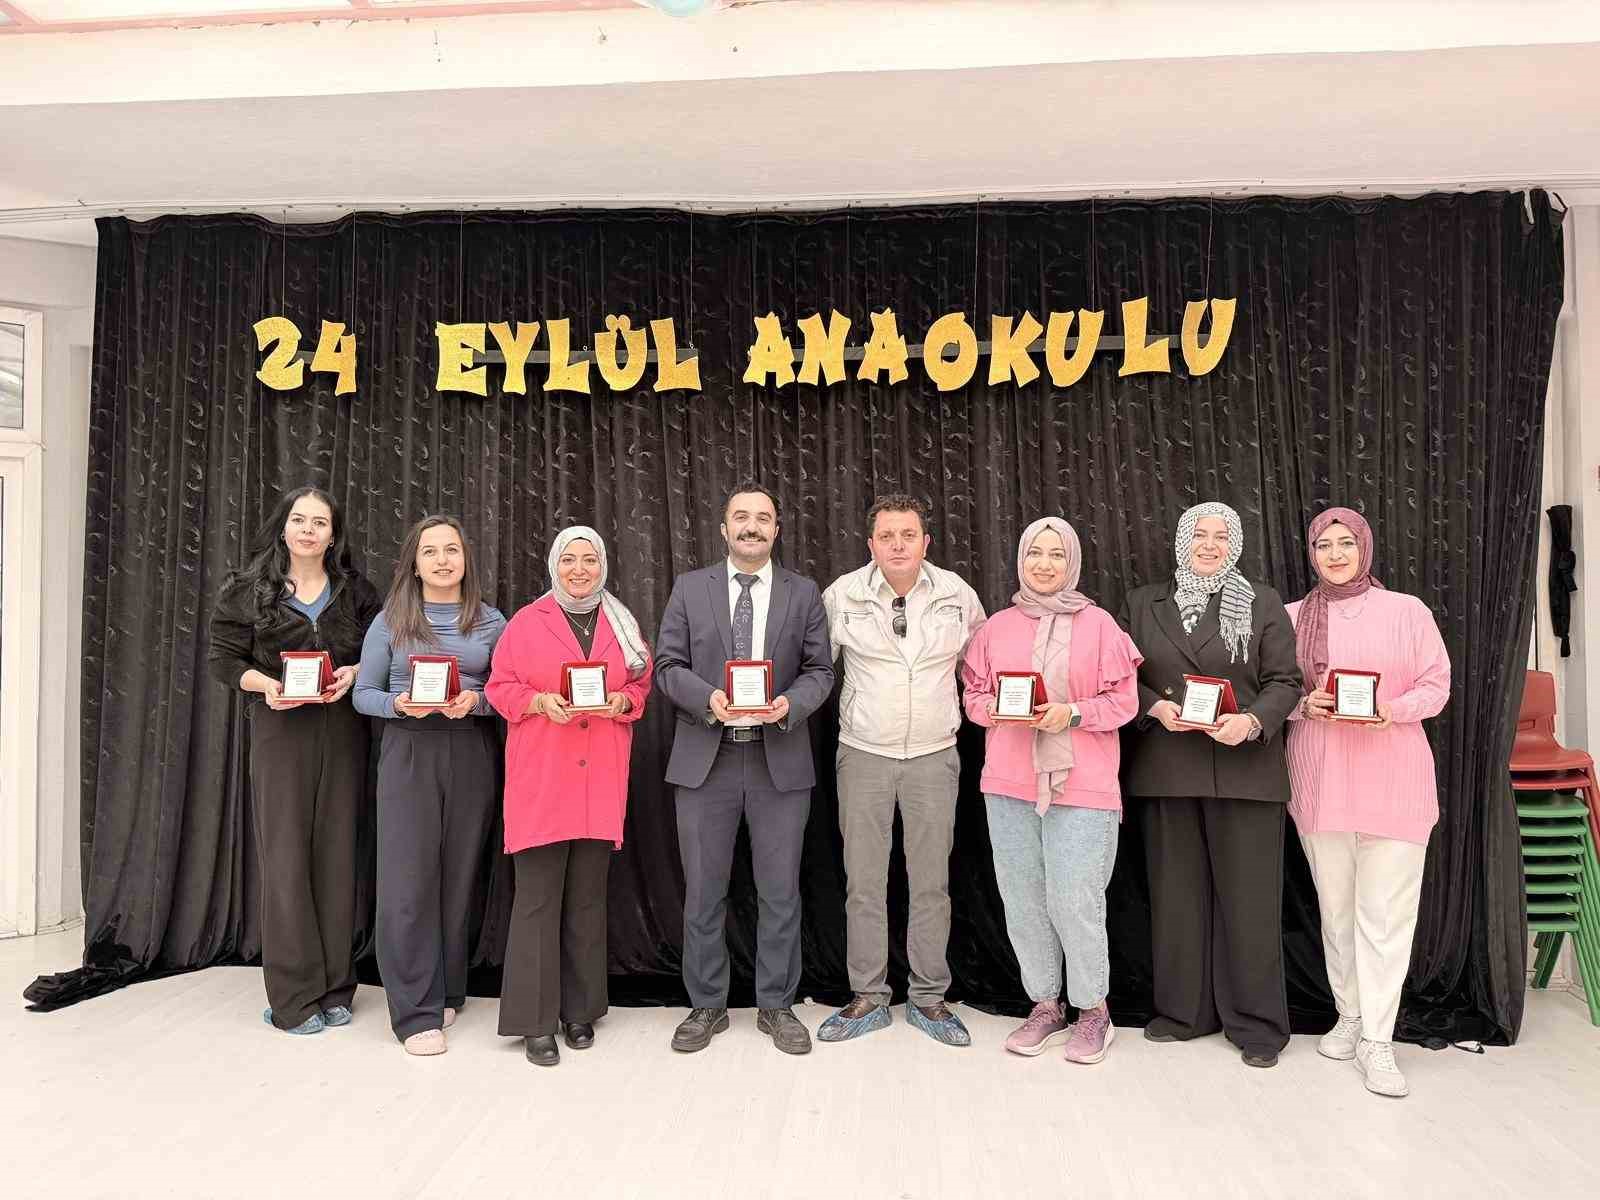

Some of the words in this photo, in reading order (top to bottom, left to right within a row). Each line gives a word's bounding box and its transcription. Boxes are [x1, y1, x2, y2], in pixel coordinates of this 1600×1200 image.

[254, 316, 358, 395] 24
[436, 314, 702, 396] EYLÜL
[743, 297, 1237, 391] ANAOKULU
